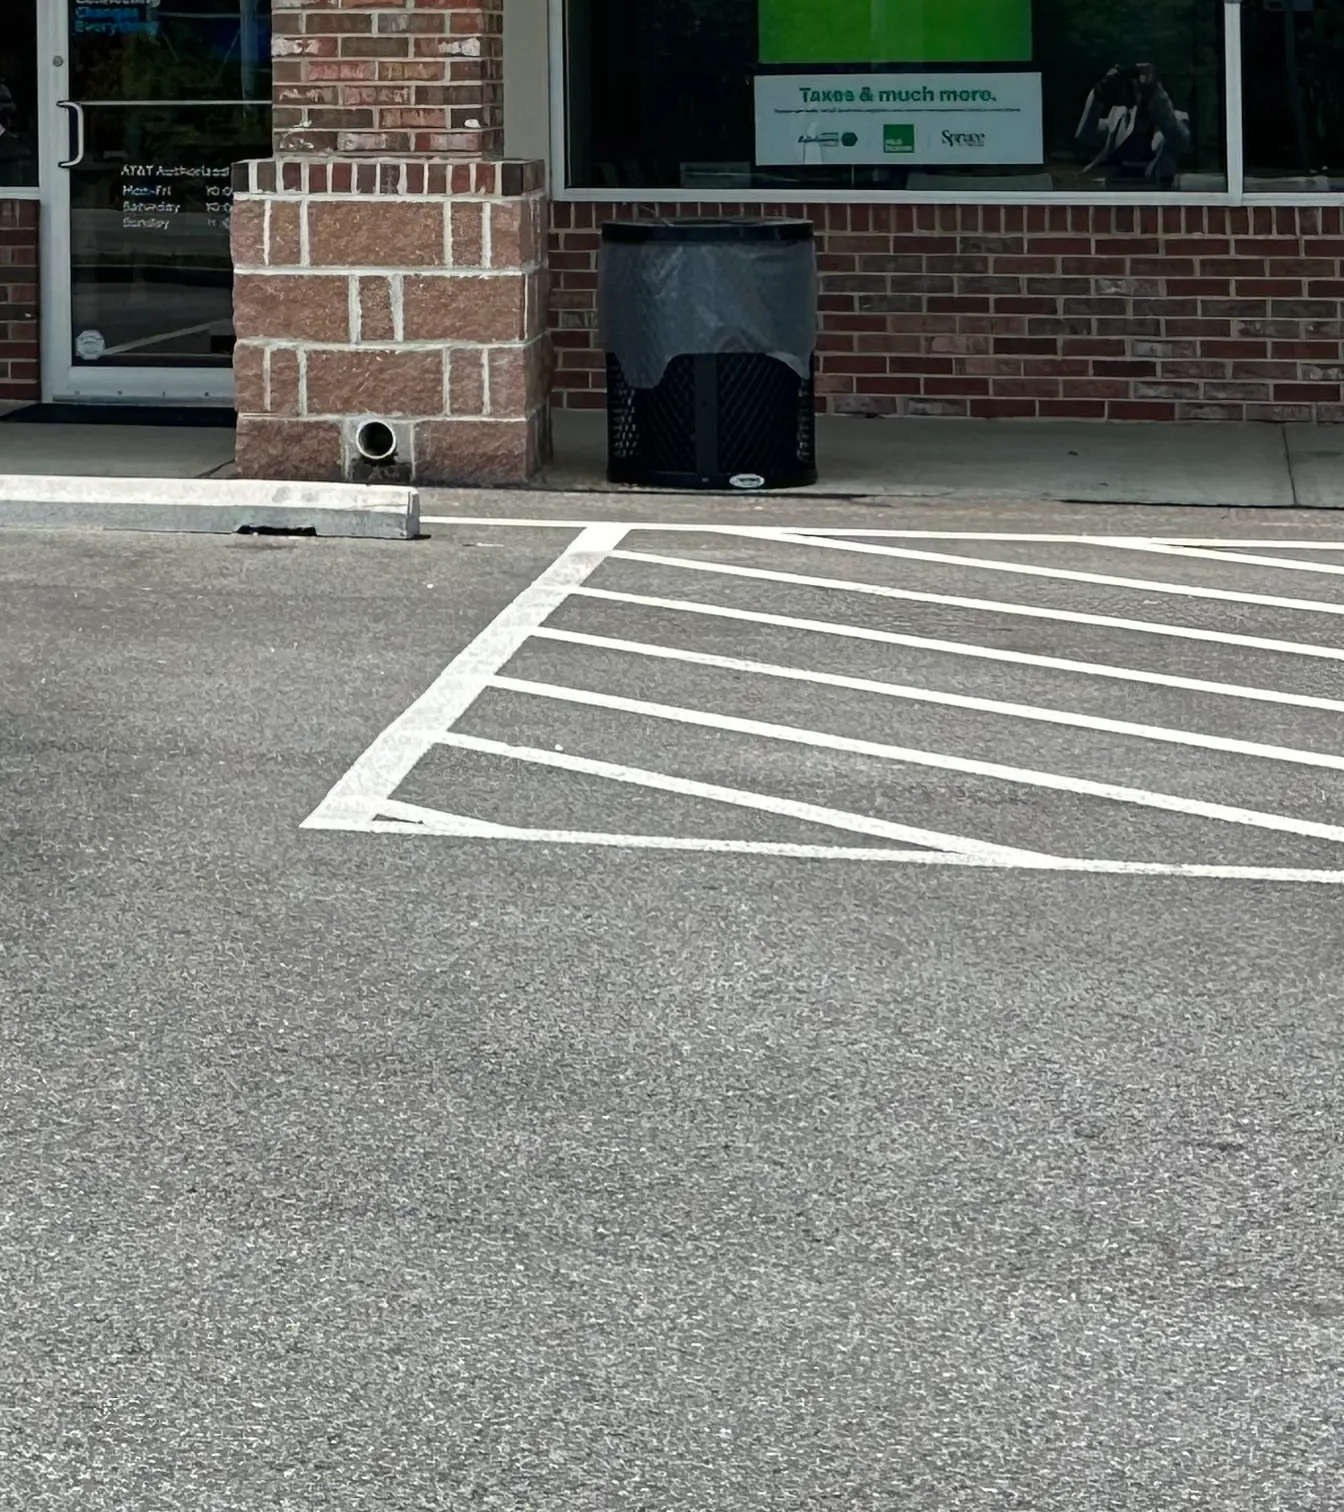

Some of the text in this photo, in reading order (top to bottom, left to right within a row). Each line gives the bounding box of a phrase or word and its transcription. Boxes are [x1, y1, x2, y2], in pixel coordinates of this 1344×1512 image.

[799, 87, 854, 103] Taxes
[859, 87, 874, 101] &
[878, 86, 935, 102] much
